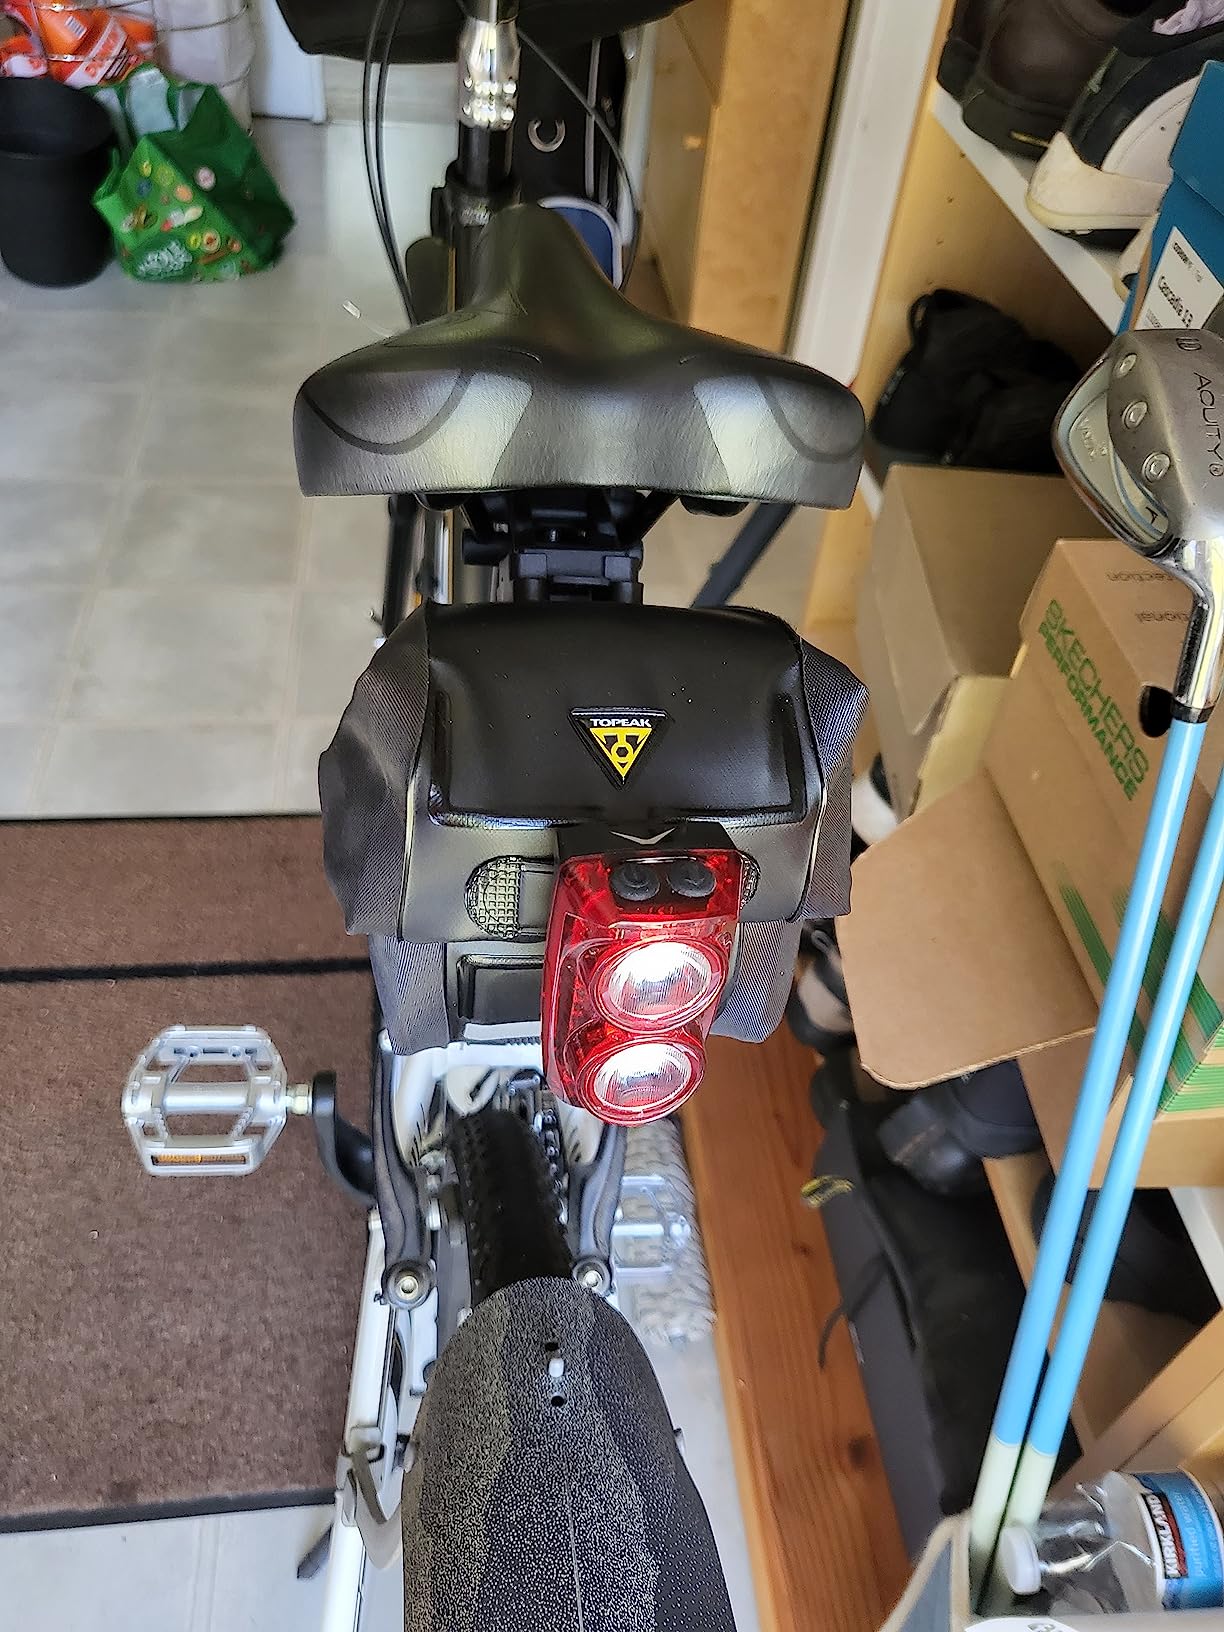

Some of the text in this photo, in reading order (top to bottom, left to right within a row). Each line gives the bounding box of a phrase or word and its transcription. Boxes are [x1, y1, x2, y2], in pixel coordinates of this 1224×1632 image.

[589, 718, 652, 728] TOPEAK
[1039, 621, 1138, 801] PERFORMANCE
[1047, 599, 1149, 784] SKECHERS
[1145, 1492, 1182, 1578] KIRKLAND
